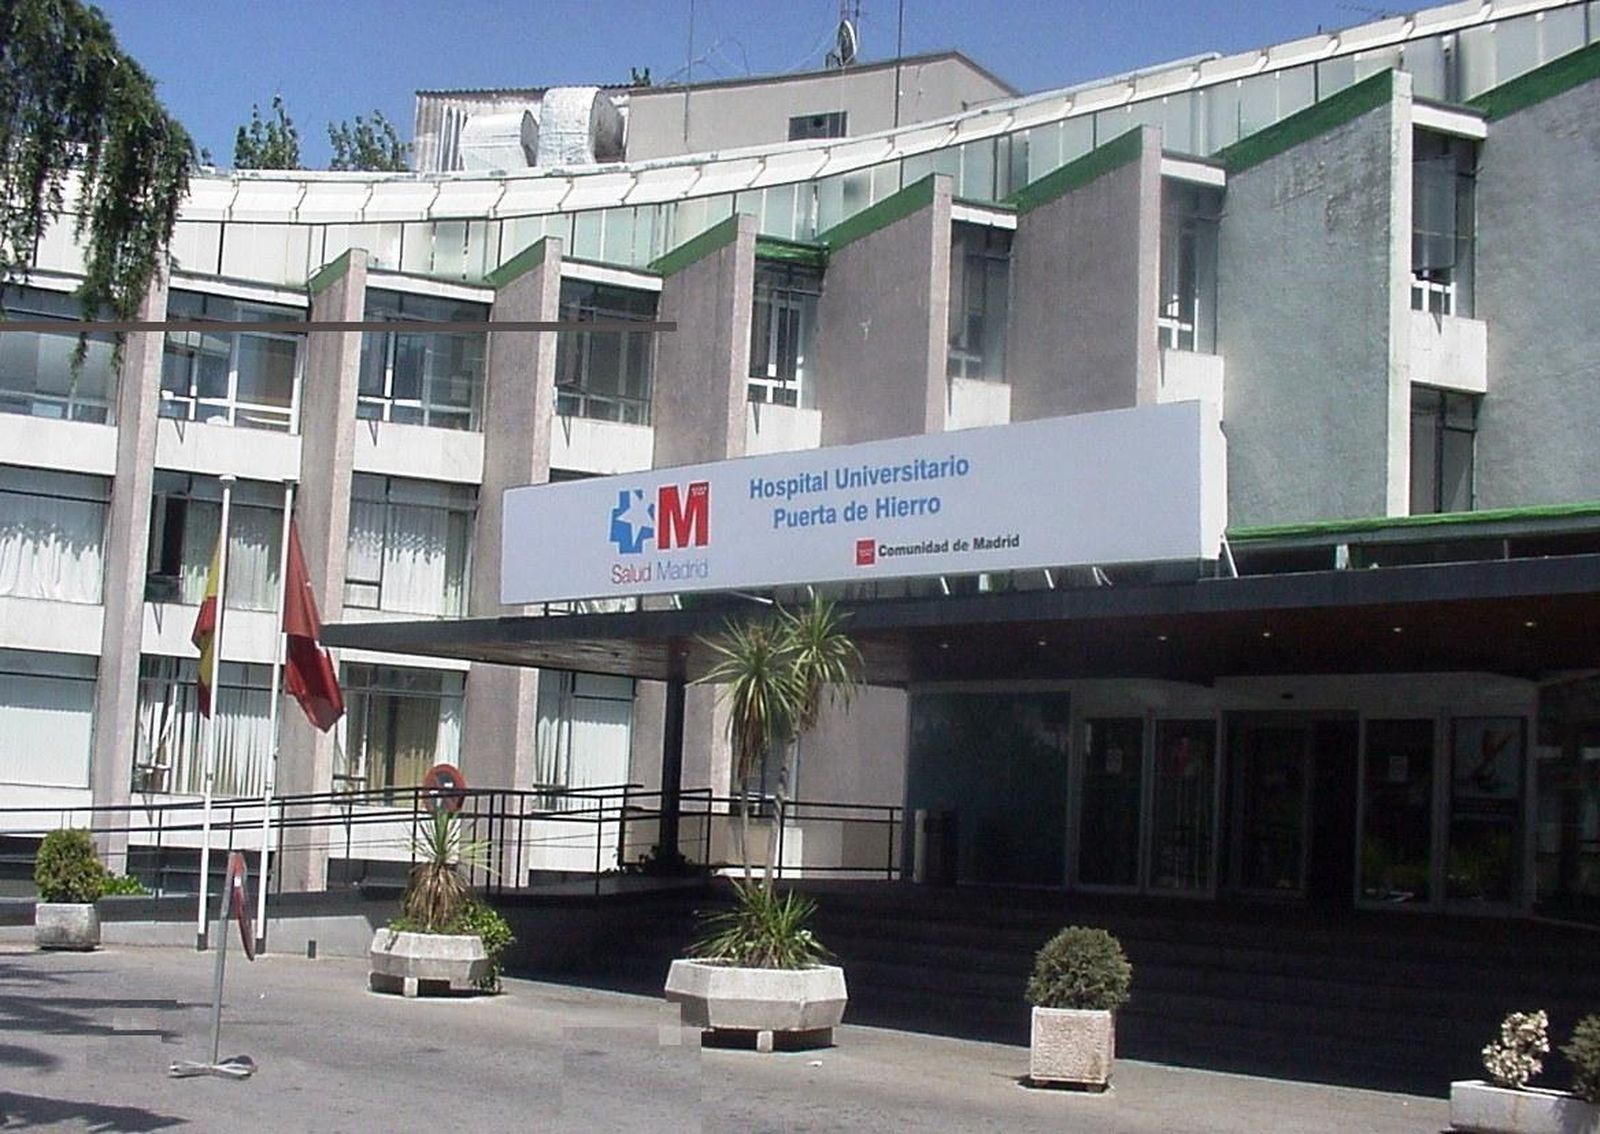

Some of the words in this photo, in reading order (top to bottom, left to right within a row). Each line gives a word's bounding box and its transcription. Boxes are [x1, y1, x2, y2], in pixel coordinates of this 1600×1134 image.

[750, 470, 828, 500] Hospital
[835, 455, 969, 489] Universitario
[657, 481, 710, 550] M
[773, 505, 836, 529] Puerta
[843, 500, 868, 522] de
[876, 496, 941, 519] Hierro
[878, 538, 949, 557] Comunidad
[952, 539, 969, 552] de
[973, 533, 1020, 550] Madrid
[611, 562, 652, 585] Salud
[657, 558, 709, 581] Madrid
